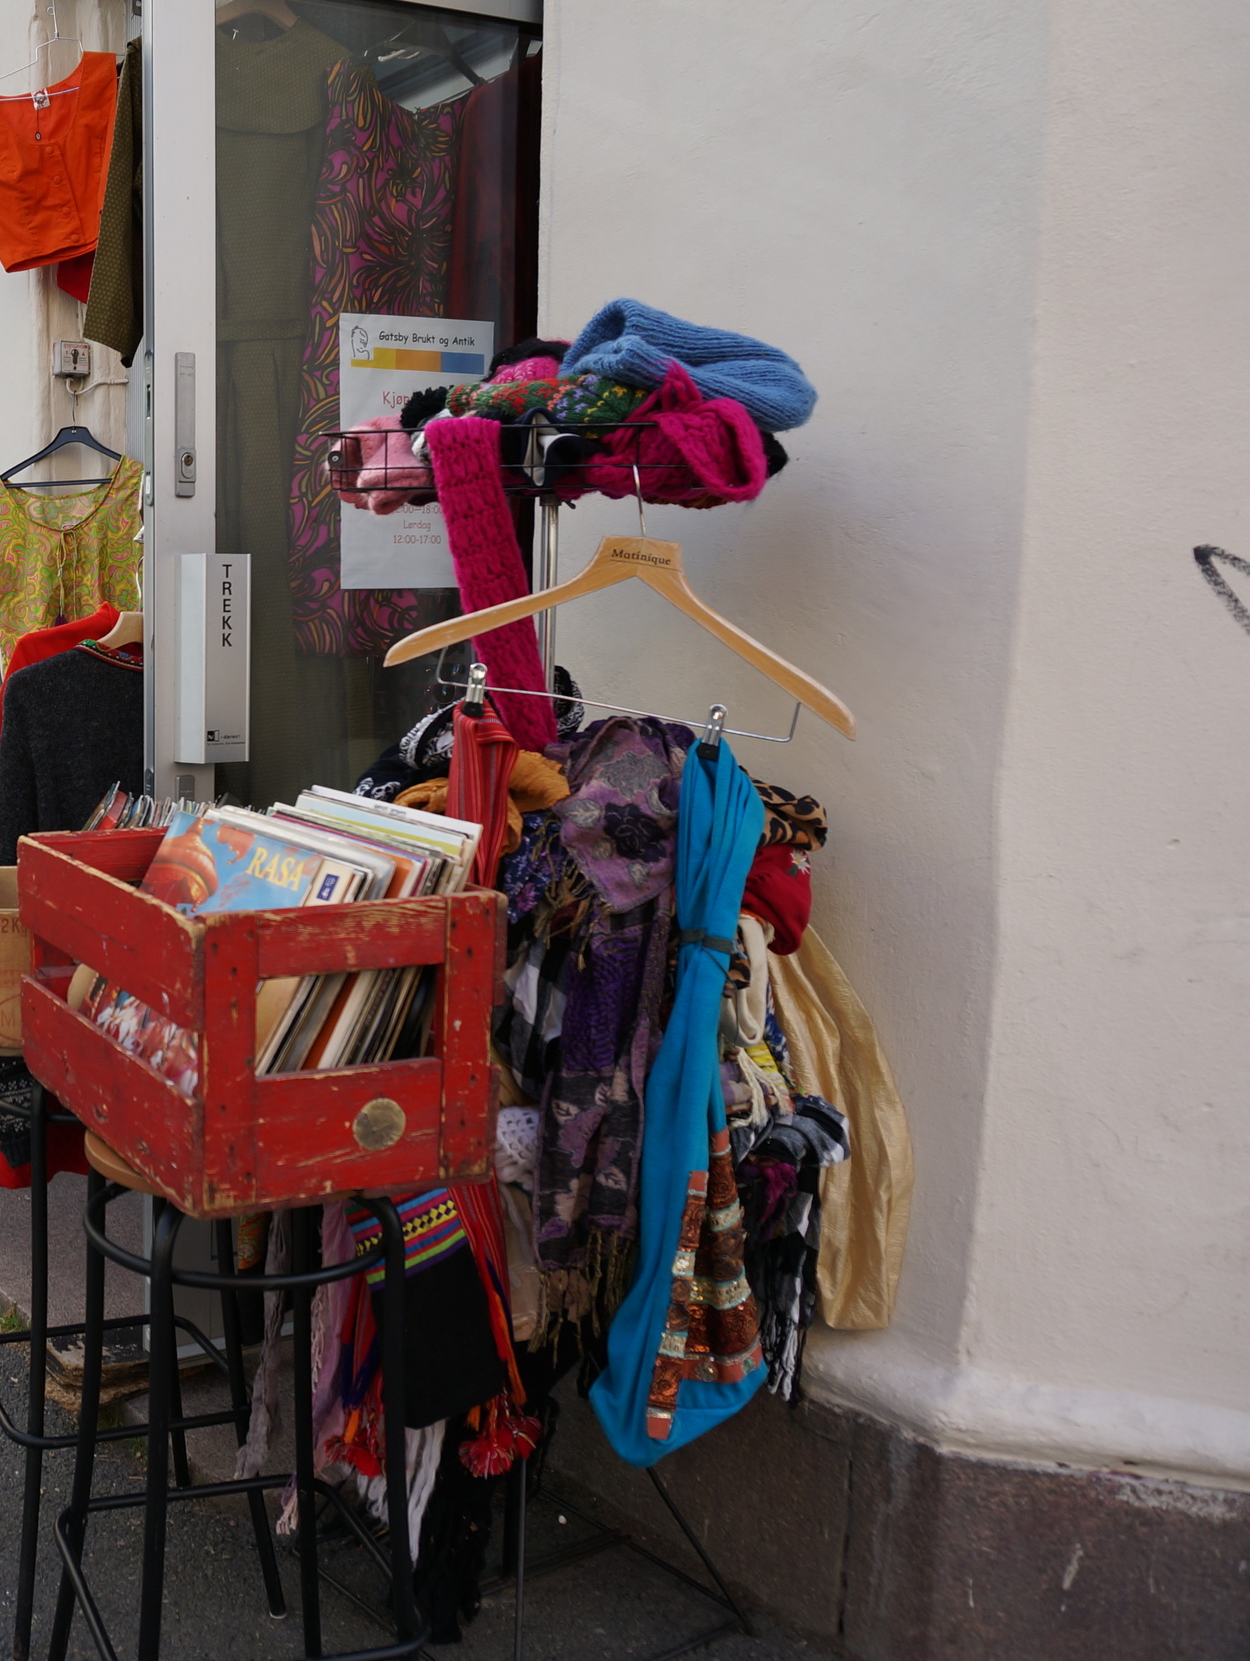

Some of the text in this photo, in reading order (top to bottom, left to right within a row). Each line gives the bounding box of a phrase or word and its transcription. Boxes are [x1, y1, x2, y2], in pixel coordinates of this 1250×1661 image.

[379, 331, 475, 347] Gatsby Brukt og Antik
[403, 520, 431, 532] Lørdag
[393, 534, 441, 544] 12:00-17:00
[611, 548, 672, 566] Matinique
[222, 564, 233, 647] TREKK
[245, 846, 306, 892] RASA
